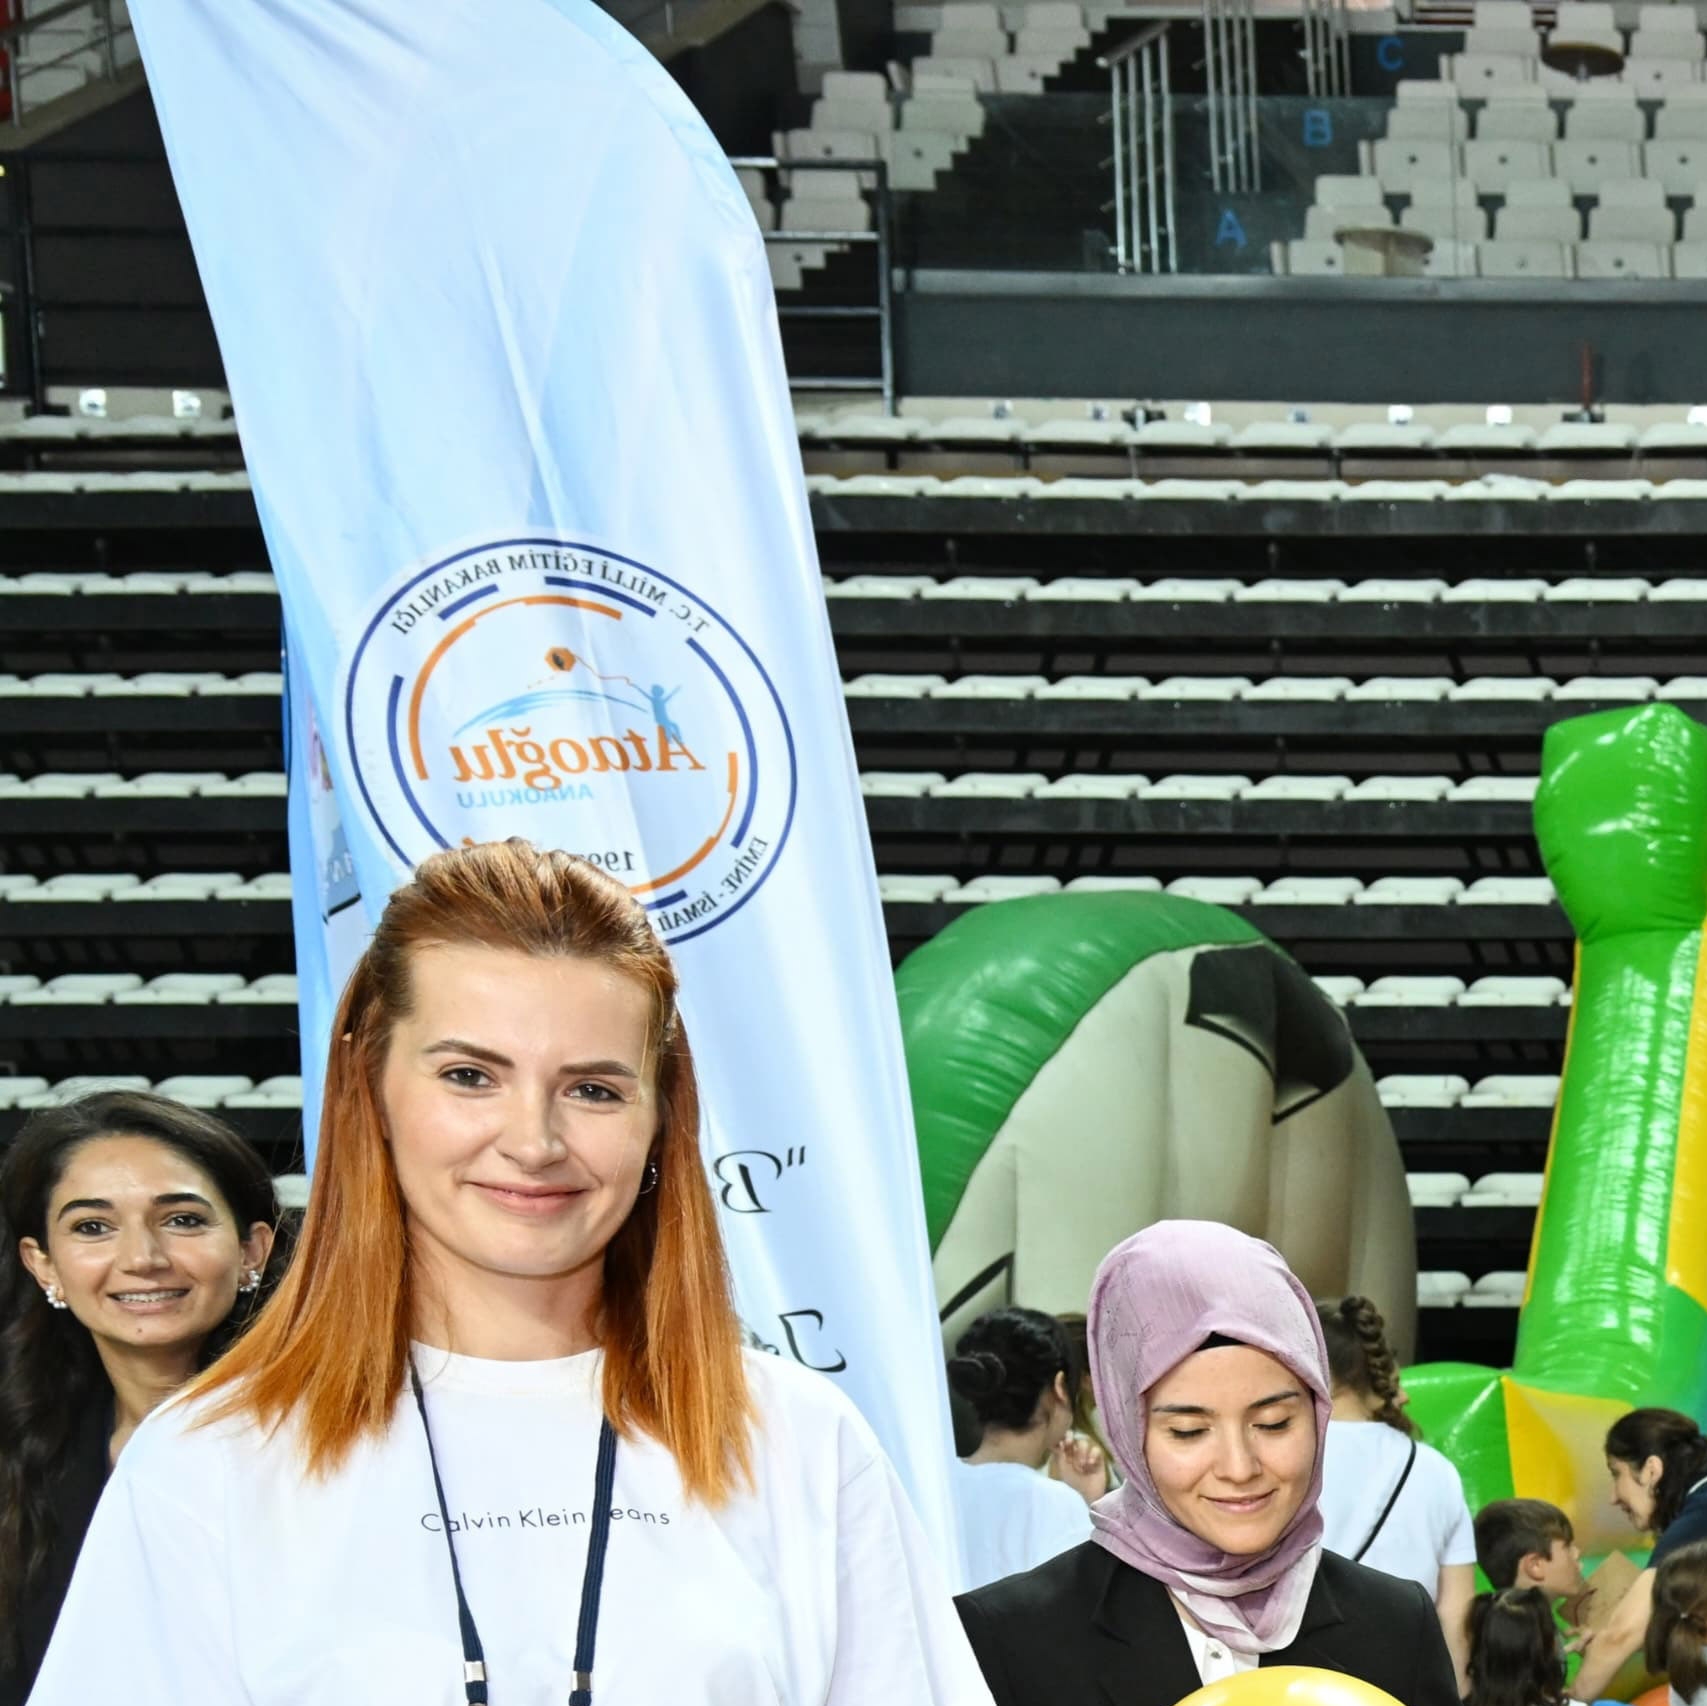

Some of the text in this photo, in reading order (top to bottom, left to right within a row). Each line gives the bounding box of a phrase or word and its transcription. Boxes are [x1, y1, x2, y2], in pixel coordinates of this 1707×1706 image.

[1376, 35, 1404, 71] C
[1303, 108, 1333, 147] B
[1215, 208, 1247, 247] A
[421, 1507, 671, 1532] Calvin Klein eans
